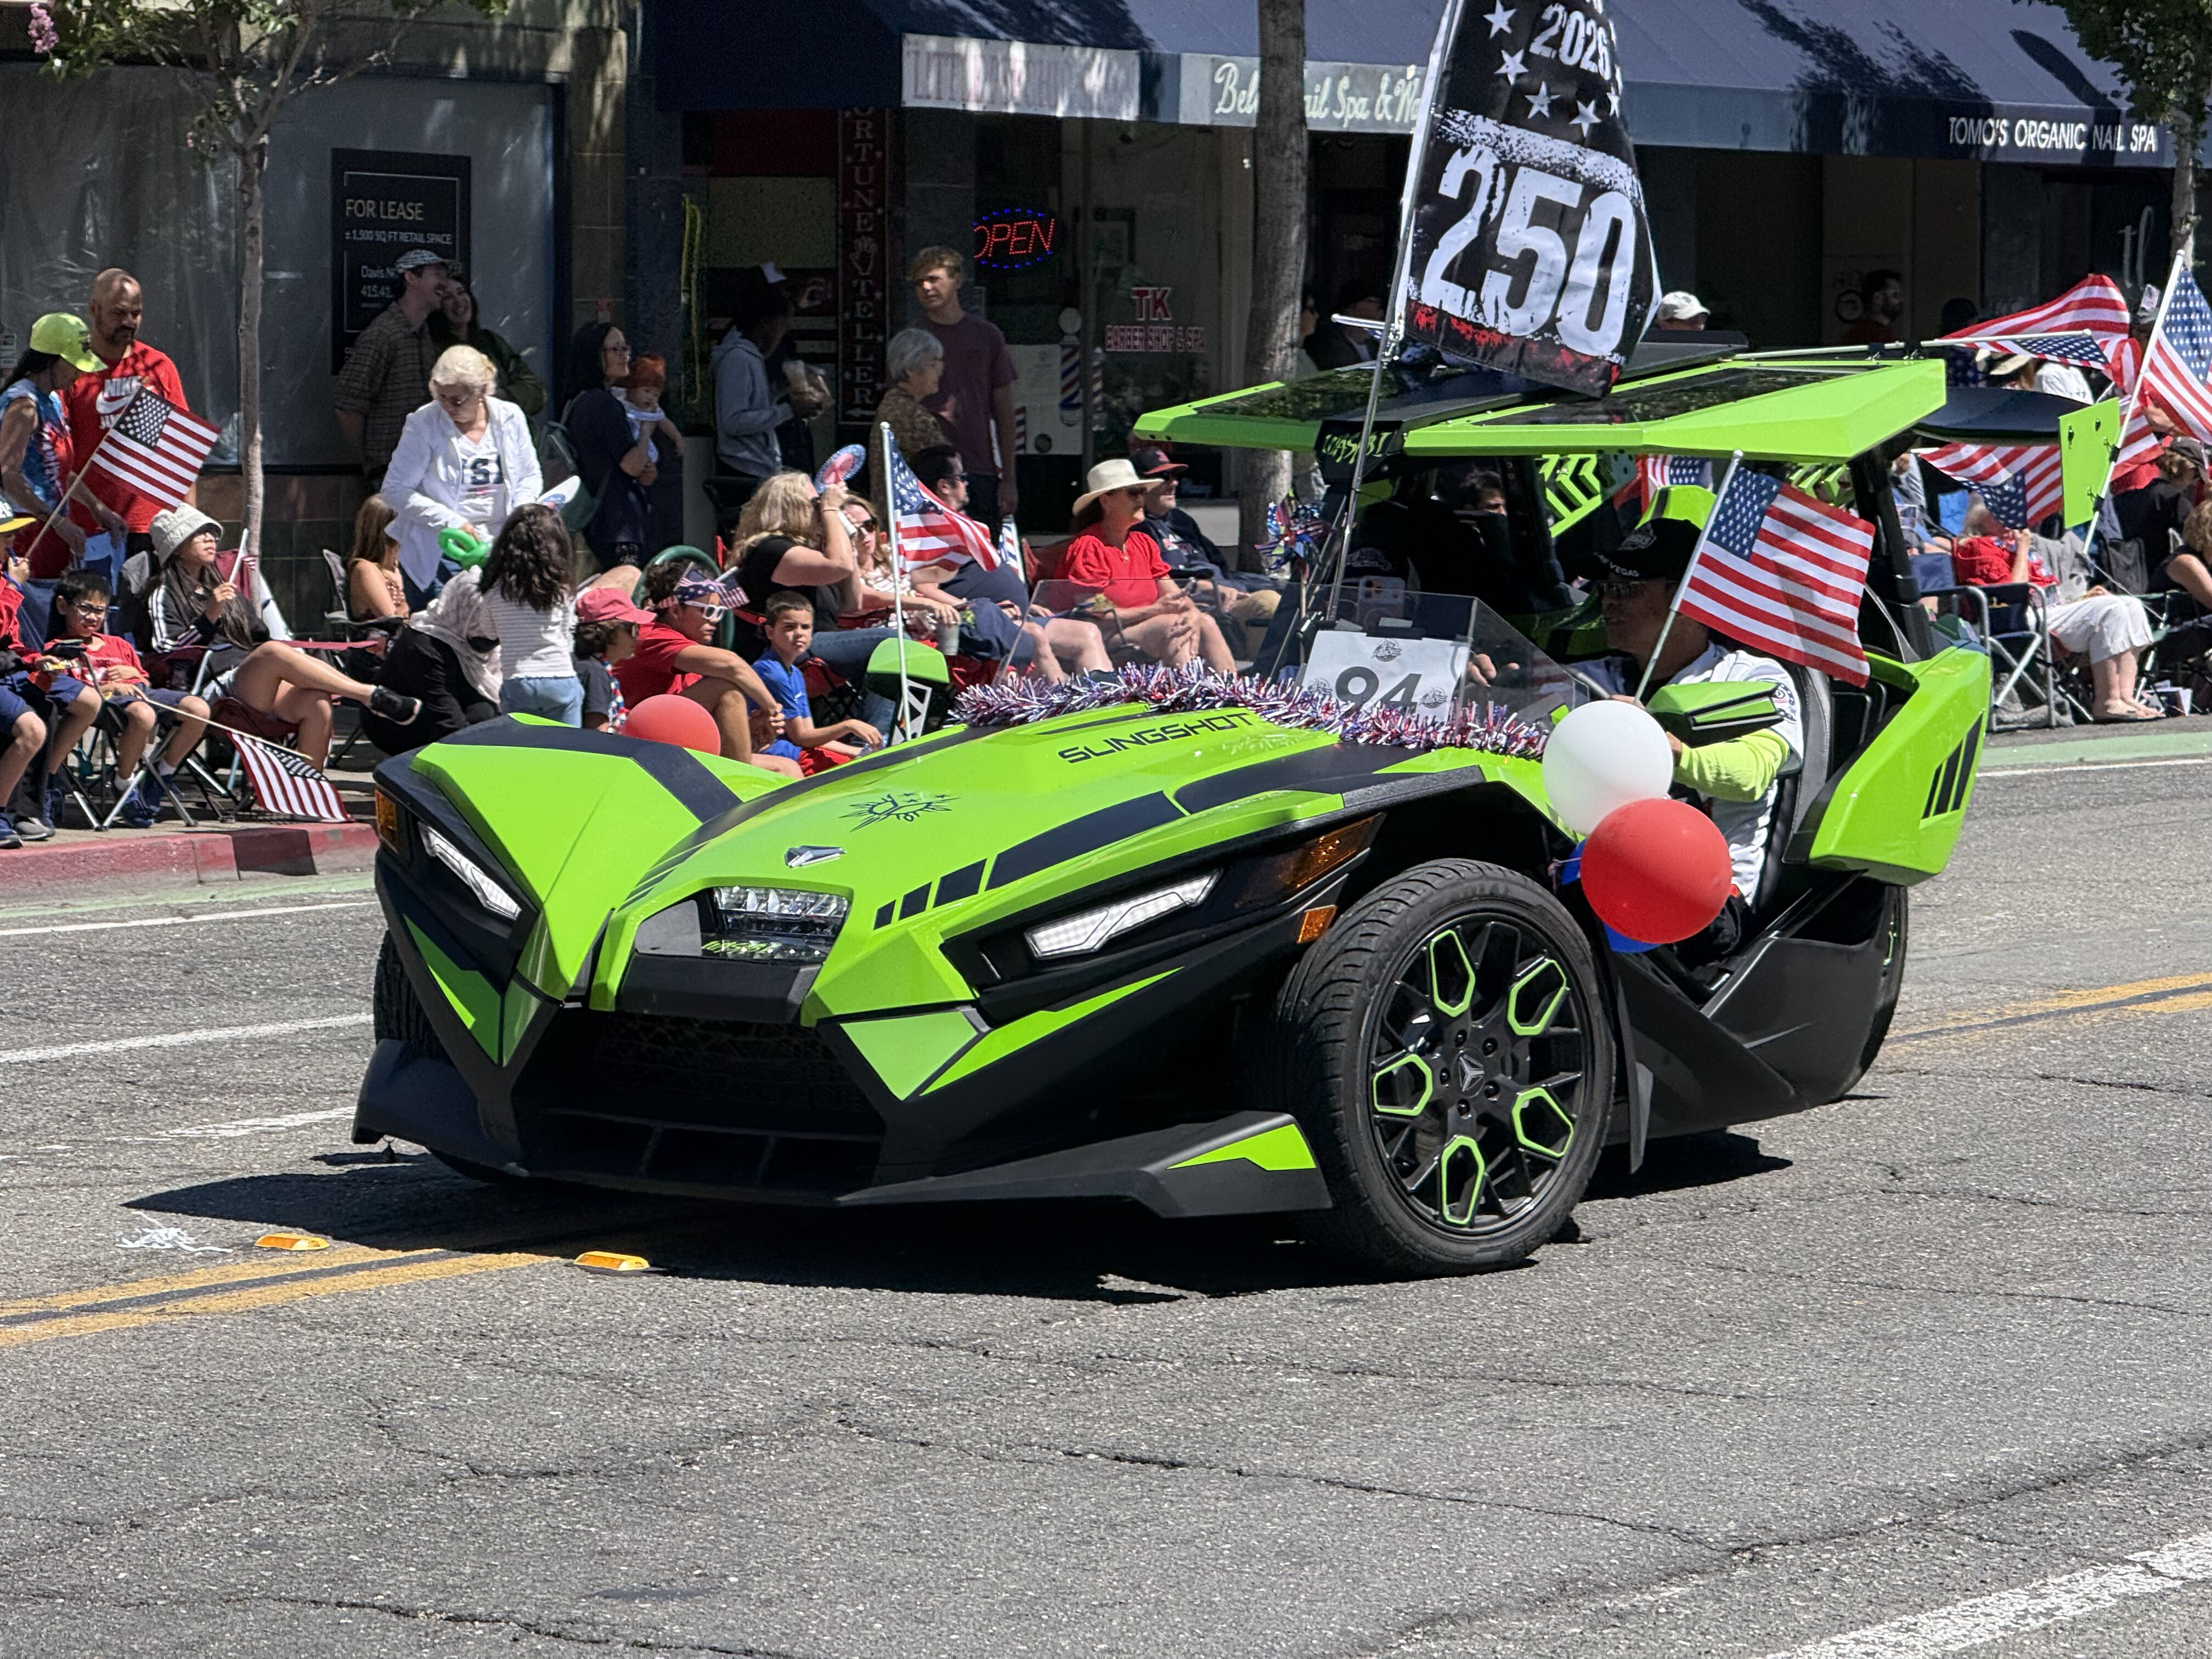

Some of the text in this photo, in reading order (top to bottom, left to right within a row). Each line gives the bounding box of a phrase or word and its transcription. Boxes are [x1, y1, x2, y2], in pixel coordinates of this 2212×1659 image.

[1530, 3, 1611, 81] 2026
[1333, 76, 1370, 129] Spa
[1374, 72, 1393, 121] &
[1950, 117, 2158, 153] TOMO'S ORGANIC NAIL SPA
[345, 199, 424, 221] FOR LEASE
[388, 232, 398, 241] FT
[399, 232, 426, 243] RETAIL
[426, 233, 453, 245] SPACE
[1421, 145, 1637, 356] 250
[361, 265, 385, 278] Davis
[1131, 287, 1173, 321] TK
[852, 280, 874, 404] TELLER
[1105, 325, 1145, 352] BARBER
[1147, 326, 1175, 352] SHOP
[1186, 327, 1206, 353] SPA
[104, 376, 142, 397] NIKE
[1609, 561, 1640, 578] VEGAS
[1335, 666, 1423, 716] 94
[1058, 713, 1254, 764] SLINGSHOT
